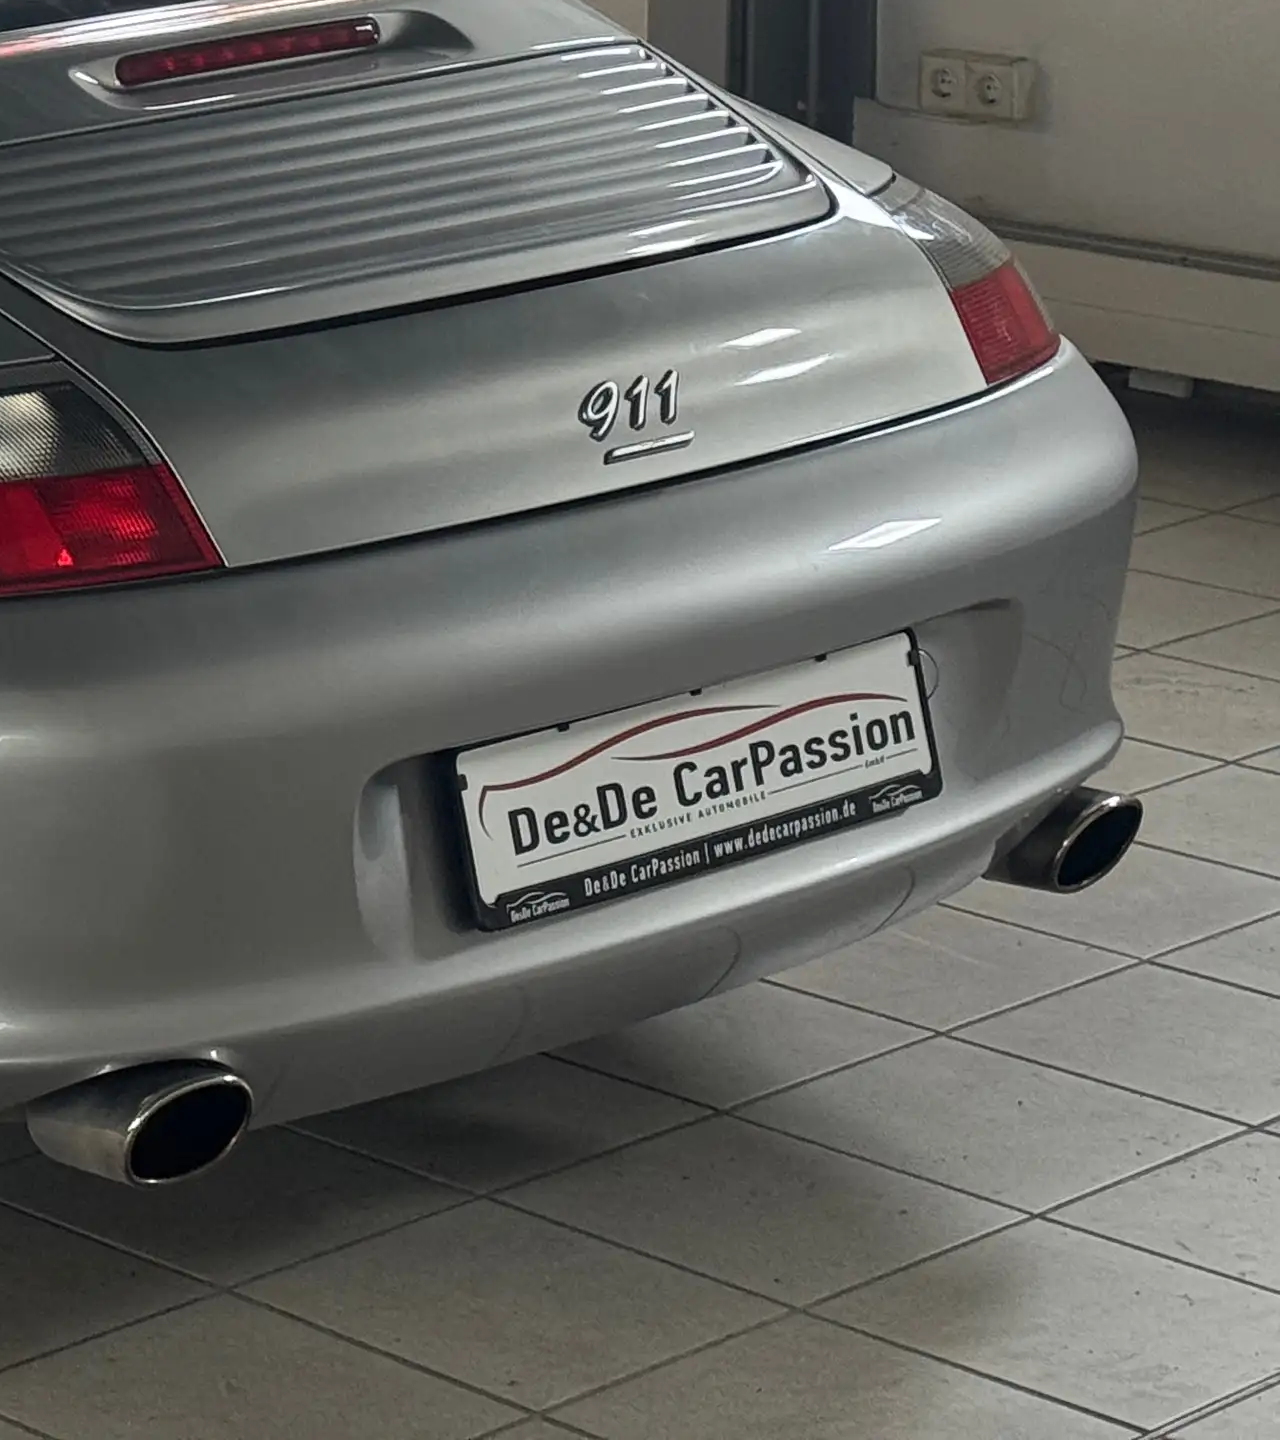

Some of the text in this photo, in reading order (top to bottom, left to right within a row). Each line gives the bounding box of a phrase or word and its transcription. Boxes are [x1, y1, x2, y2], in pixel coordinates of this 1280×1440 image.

[578, 369, 680, 442] 911
[507, 709, 916, 856] De&De CarPassion
[629, 790, 767, 839] EXKLUSIVE AUTOMOBILE
[583, 869, 627, 897] De&De
[630, 847, 701, 883] CarPassion
[713, 798, 857, 858] www.dedecarpassion.de
